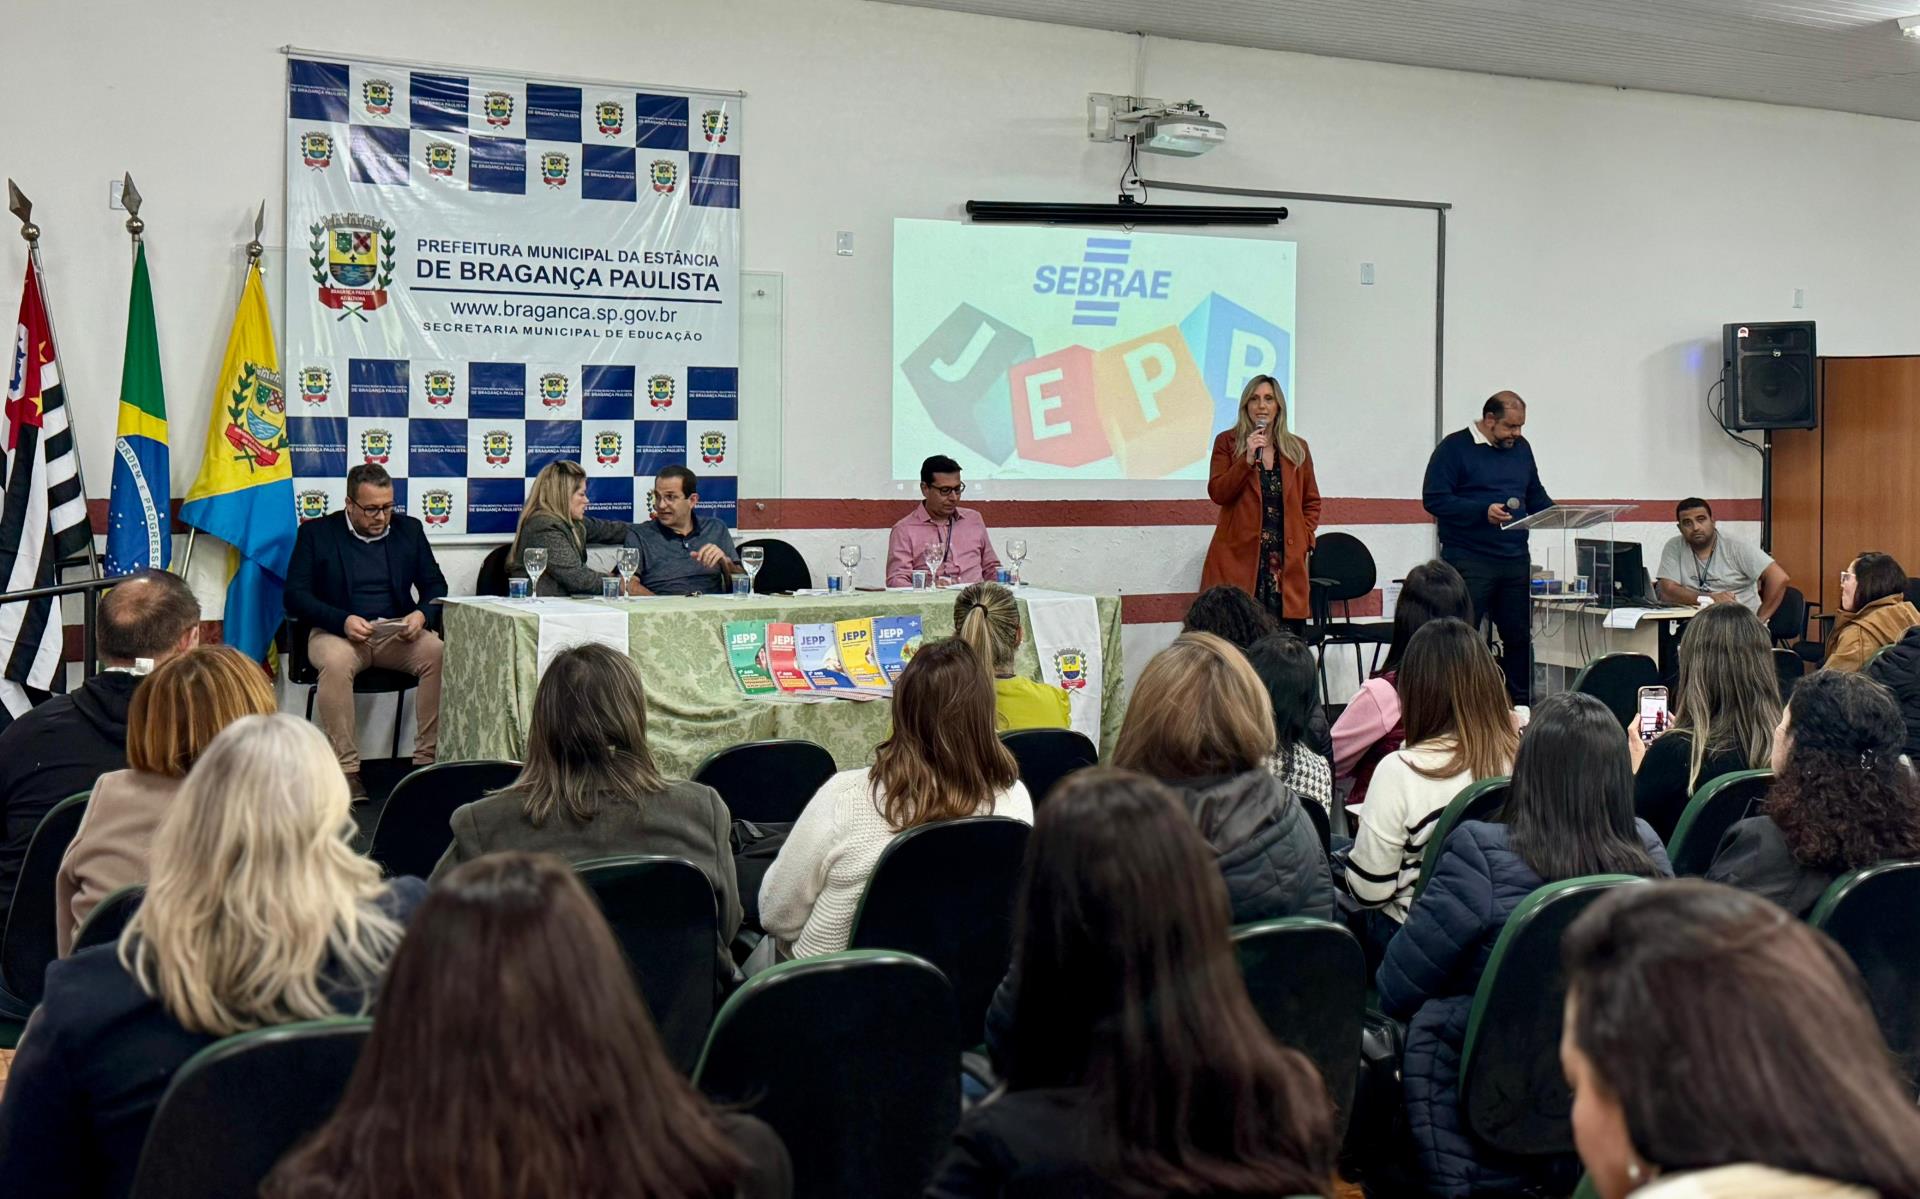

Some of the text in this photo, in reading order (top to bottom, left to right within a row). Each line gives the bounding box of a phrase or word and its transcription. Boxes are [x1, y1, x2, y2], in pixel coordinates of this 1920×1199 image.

[417, 238, 719, 267] PREFEITURA MUNICIPAL DA ESTÂNCIA
[417, 258, 720, 292] DE BRAGANÇA PAULISTA
[1032, 264, 1173, 299] SEBRAE
[450, 299, 677, 325] www.braganca.sp.gov.br
[423, 322, 703, 343] SECRETARIA MUNICIPAL DE EDUCAÇÃO
[117, 440, 141, 479] ORDEM
[731, 633, 758, 644] JEPP
[801, 635, 826, 646] JEPP
[842, 629, 867, 642] JEPP
[878, 628, 904, 638] JEPP
